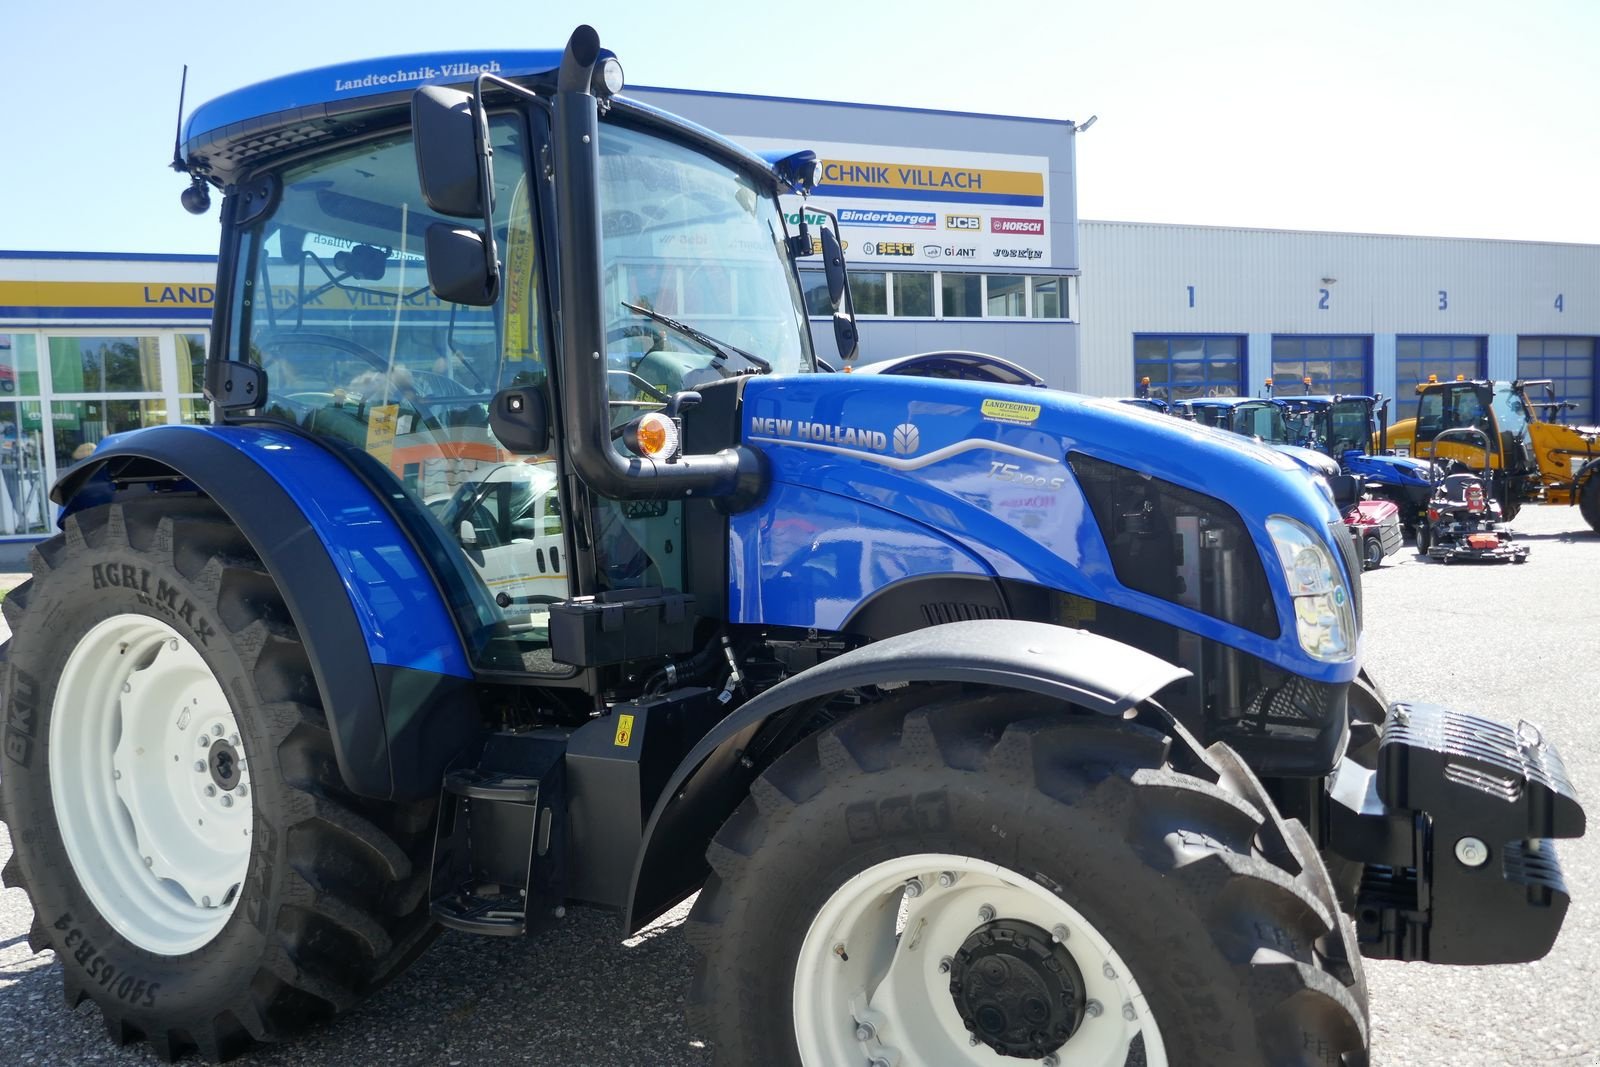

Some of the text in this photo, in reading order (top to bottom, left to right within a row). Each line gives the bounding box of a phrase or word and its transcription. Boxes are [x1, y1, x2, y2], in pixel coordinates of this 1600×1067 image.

[335, 60, 501, 92] Landtechnik-Villach
[821, 163, 982, 189] CHNIK VILLACH
[840, 211, 934, 225] Binderberger
[947, 217, 980, 229] JCB
[1002, 221, 1041, 232] HORSCH
[1187, 286, 1195, 307] 1
[1318, 289, 1330, 309] 2
[1438, 291, 1448, 310] 3
[1553, 294, 1563, 312] 4
[985, 400, 1037, 412] LANDTECHNIK
[752, 416, 887, 450] NEW HOLLAND
[5, 667, 36, 768] BKT
